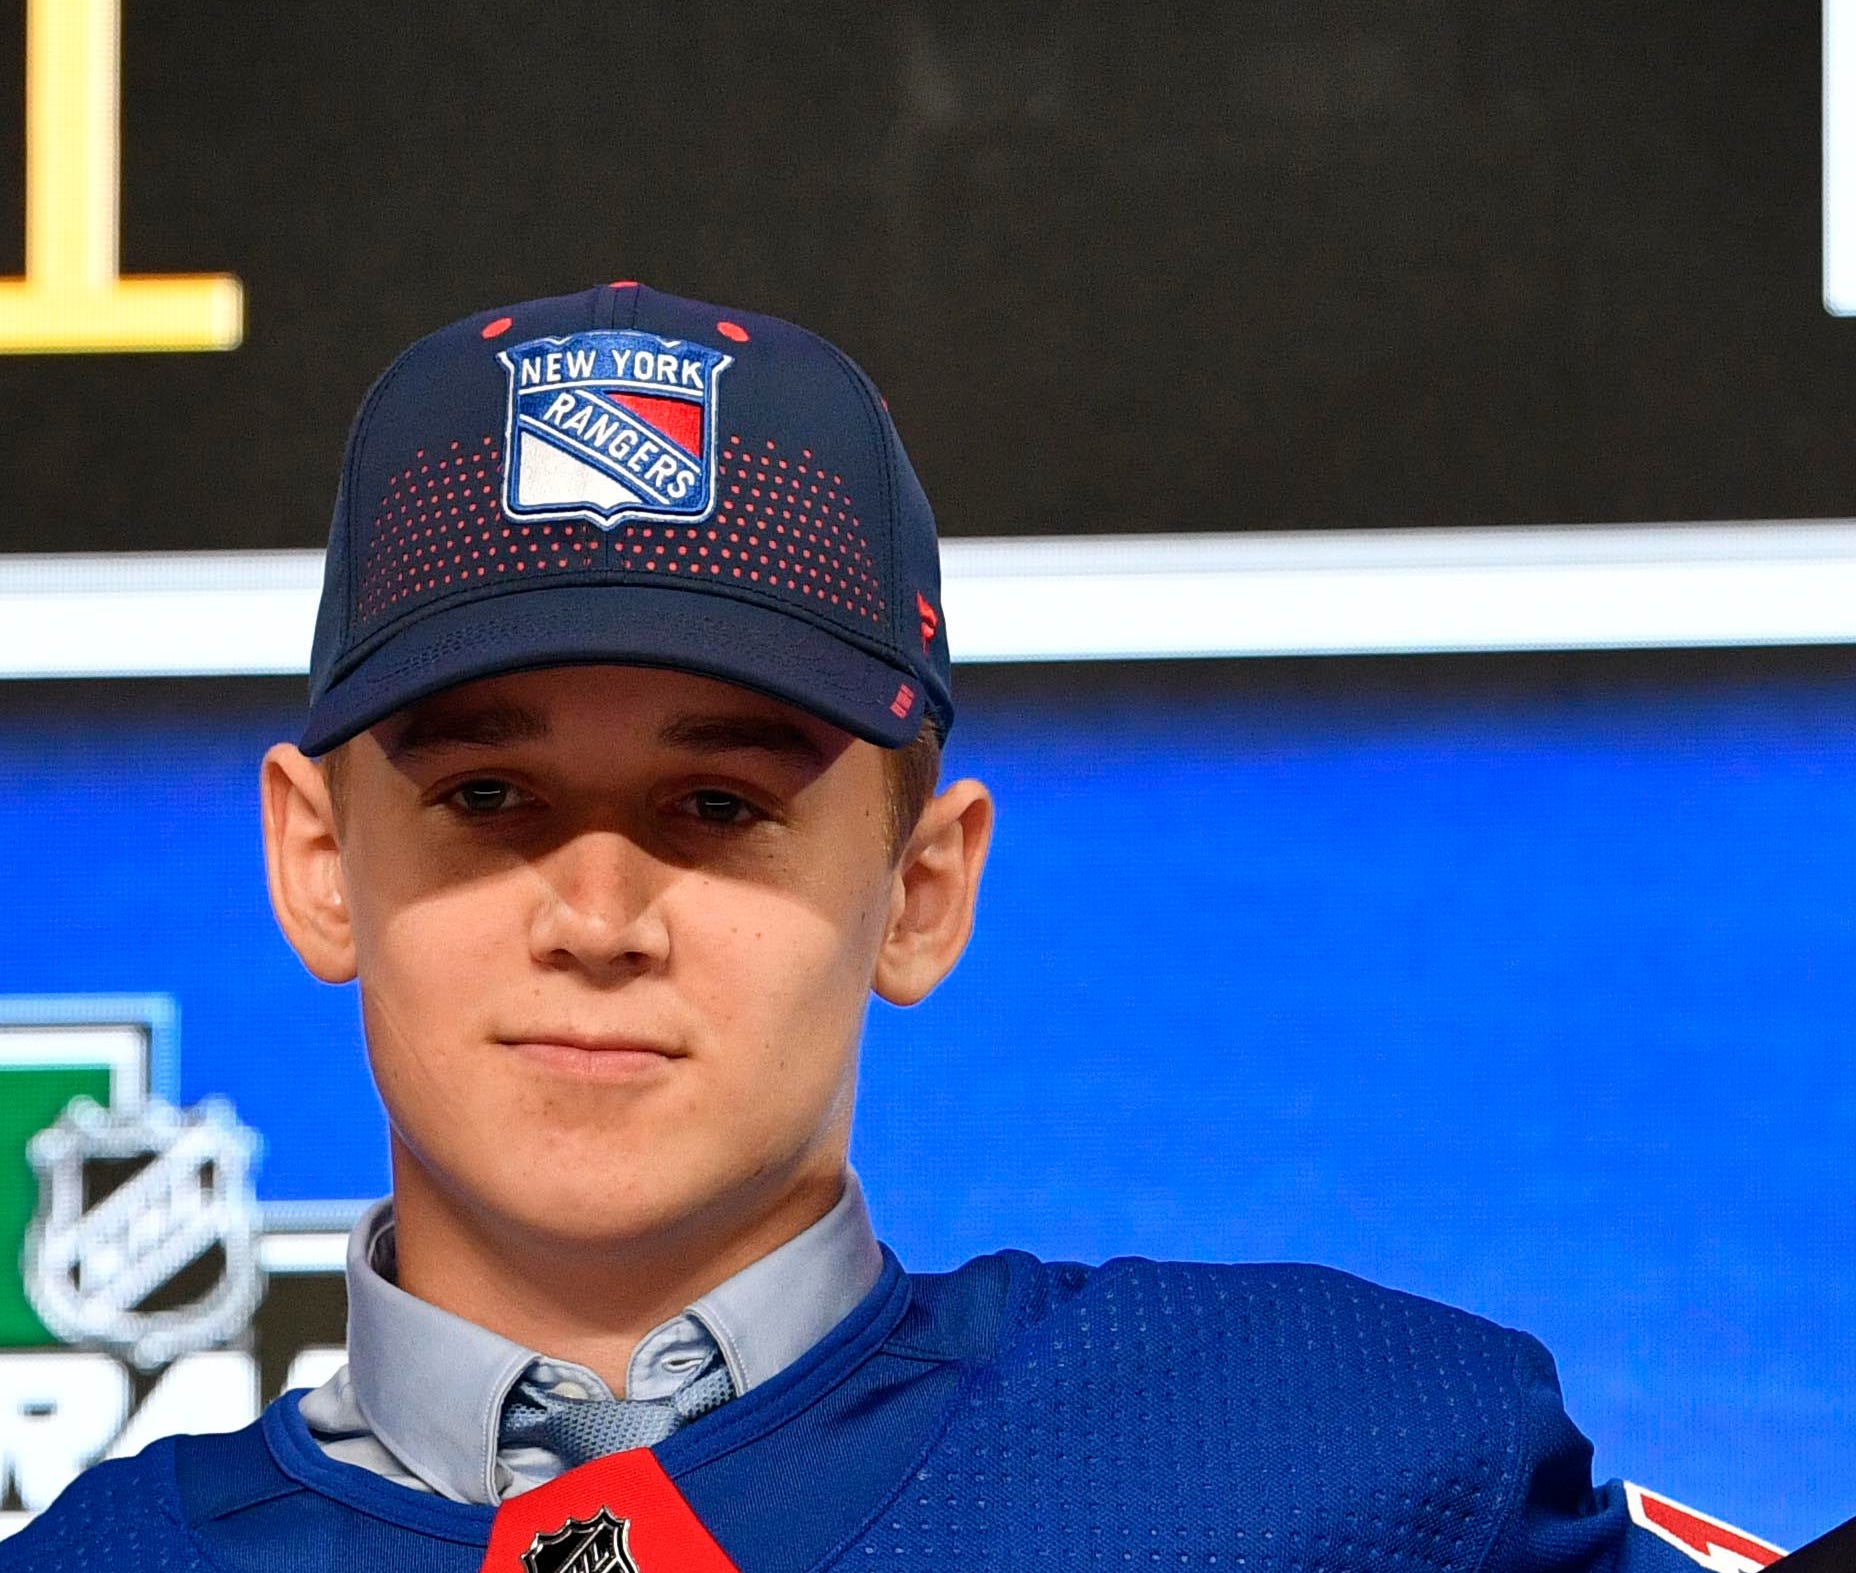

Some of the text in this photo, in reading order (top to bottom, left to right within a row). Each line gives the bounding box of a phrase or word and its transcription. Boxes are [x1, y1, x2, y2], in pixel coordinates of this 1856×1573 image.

[520, 348, 704, 390] NEW YORK
[543, 392, 696, 500] RANGERS
